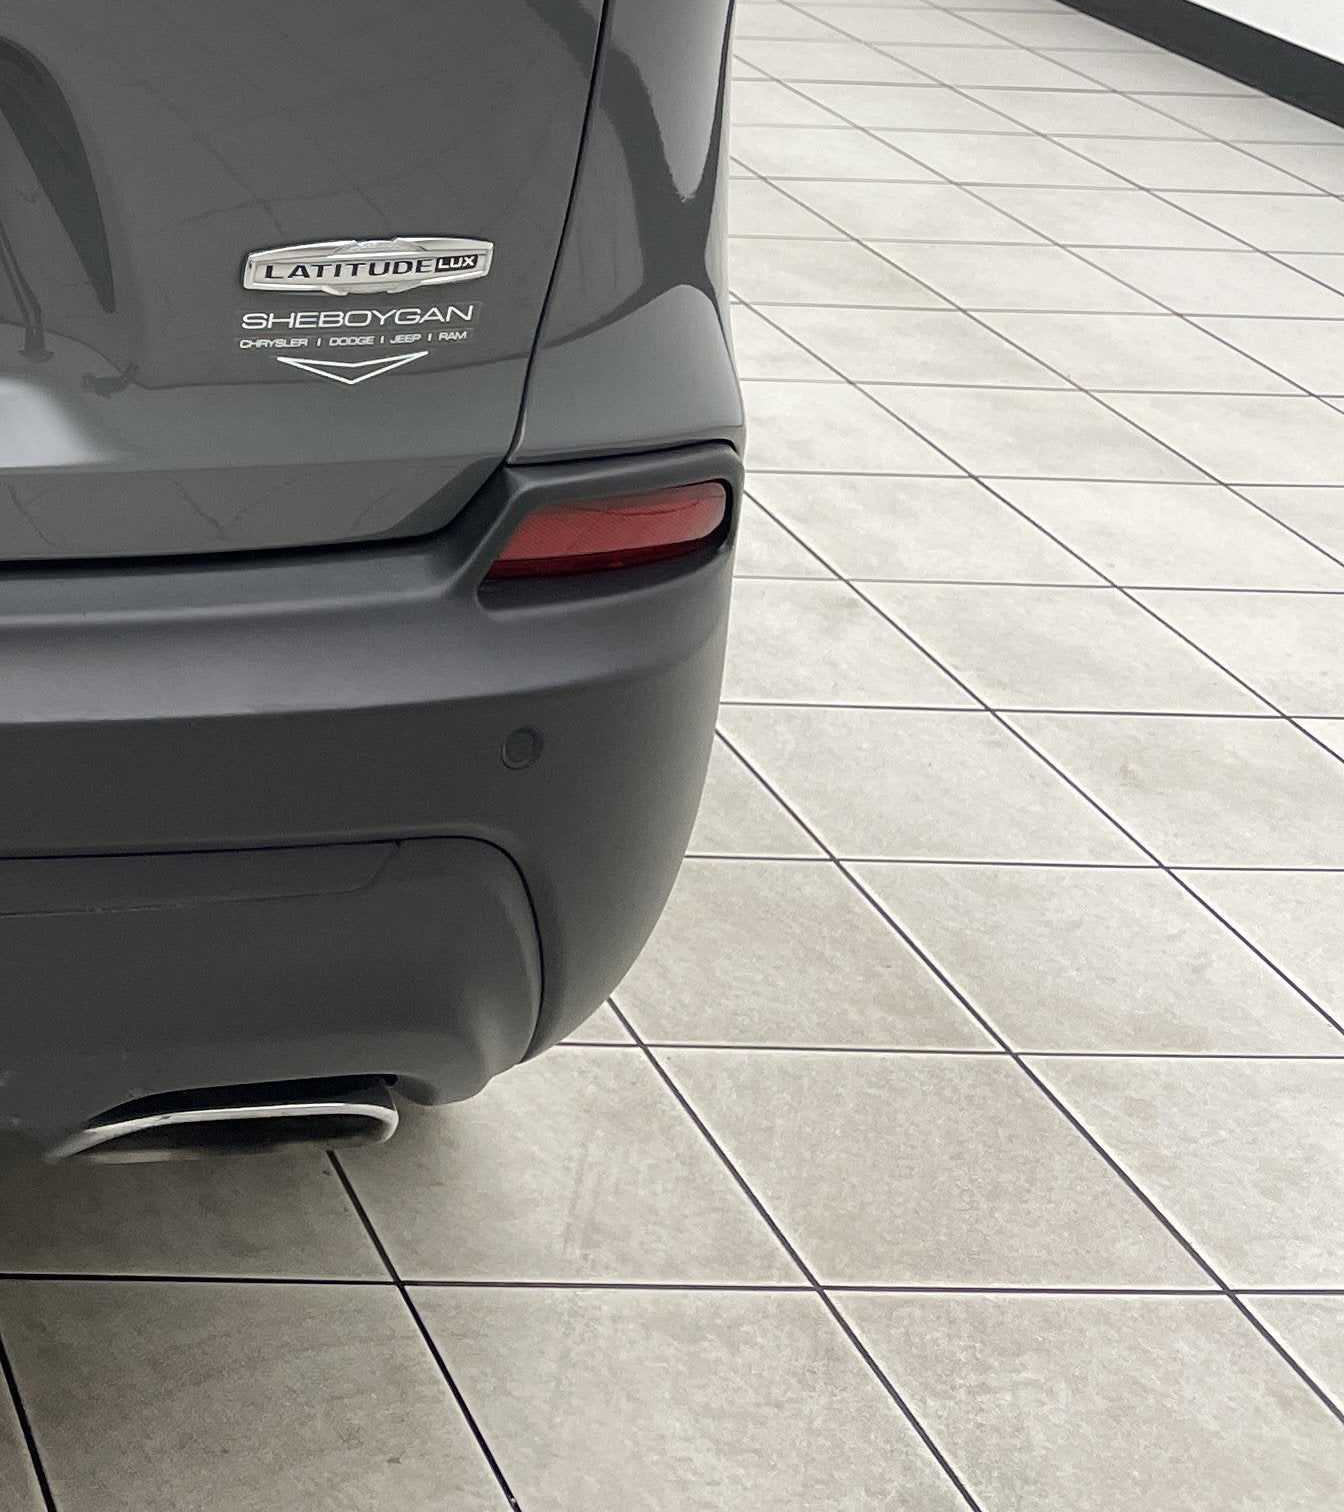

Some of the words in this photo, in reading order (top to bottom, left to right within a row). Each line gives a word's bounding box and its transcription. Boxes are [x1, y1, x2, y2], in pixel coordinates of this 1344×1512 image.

[264, 258, 435, 280] LATITUDE
[437, 255, 477, 270] LUX
[240, 305, 474, 330] SHEBOYGAN
[239, 337, 308, 349] CHRYSLER
[328, 336, 375, 346] DODGE
[389, 333, 422, 344] JEEP
[438, 331, 467, 341] RAM
